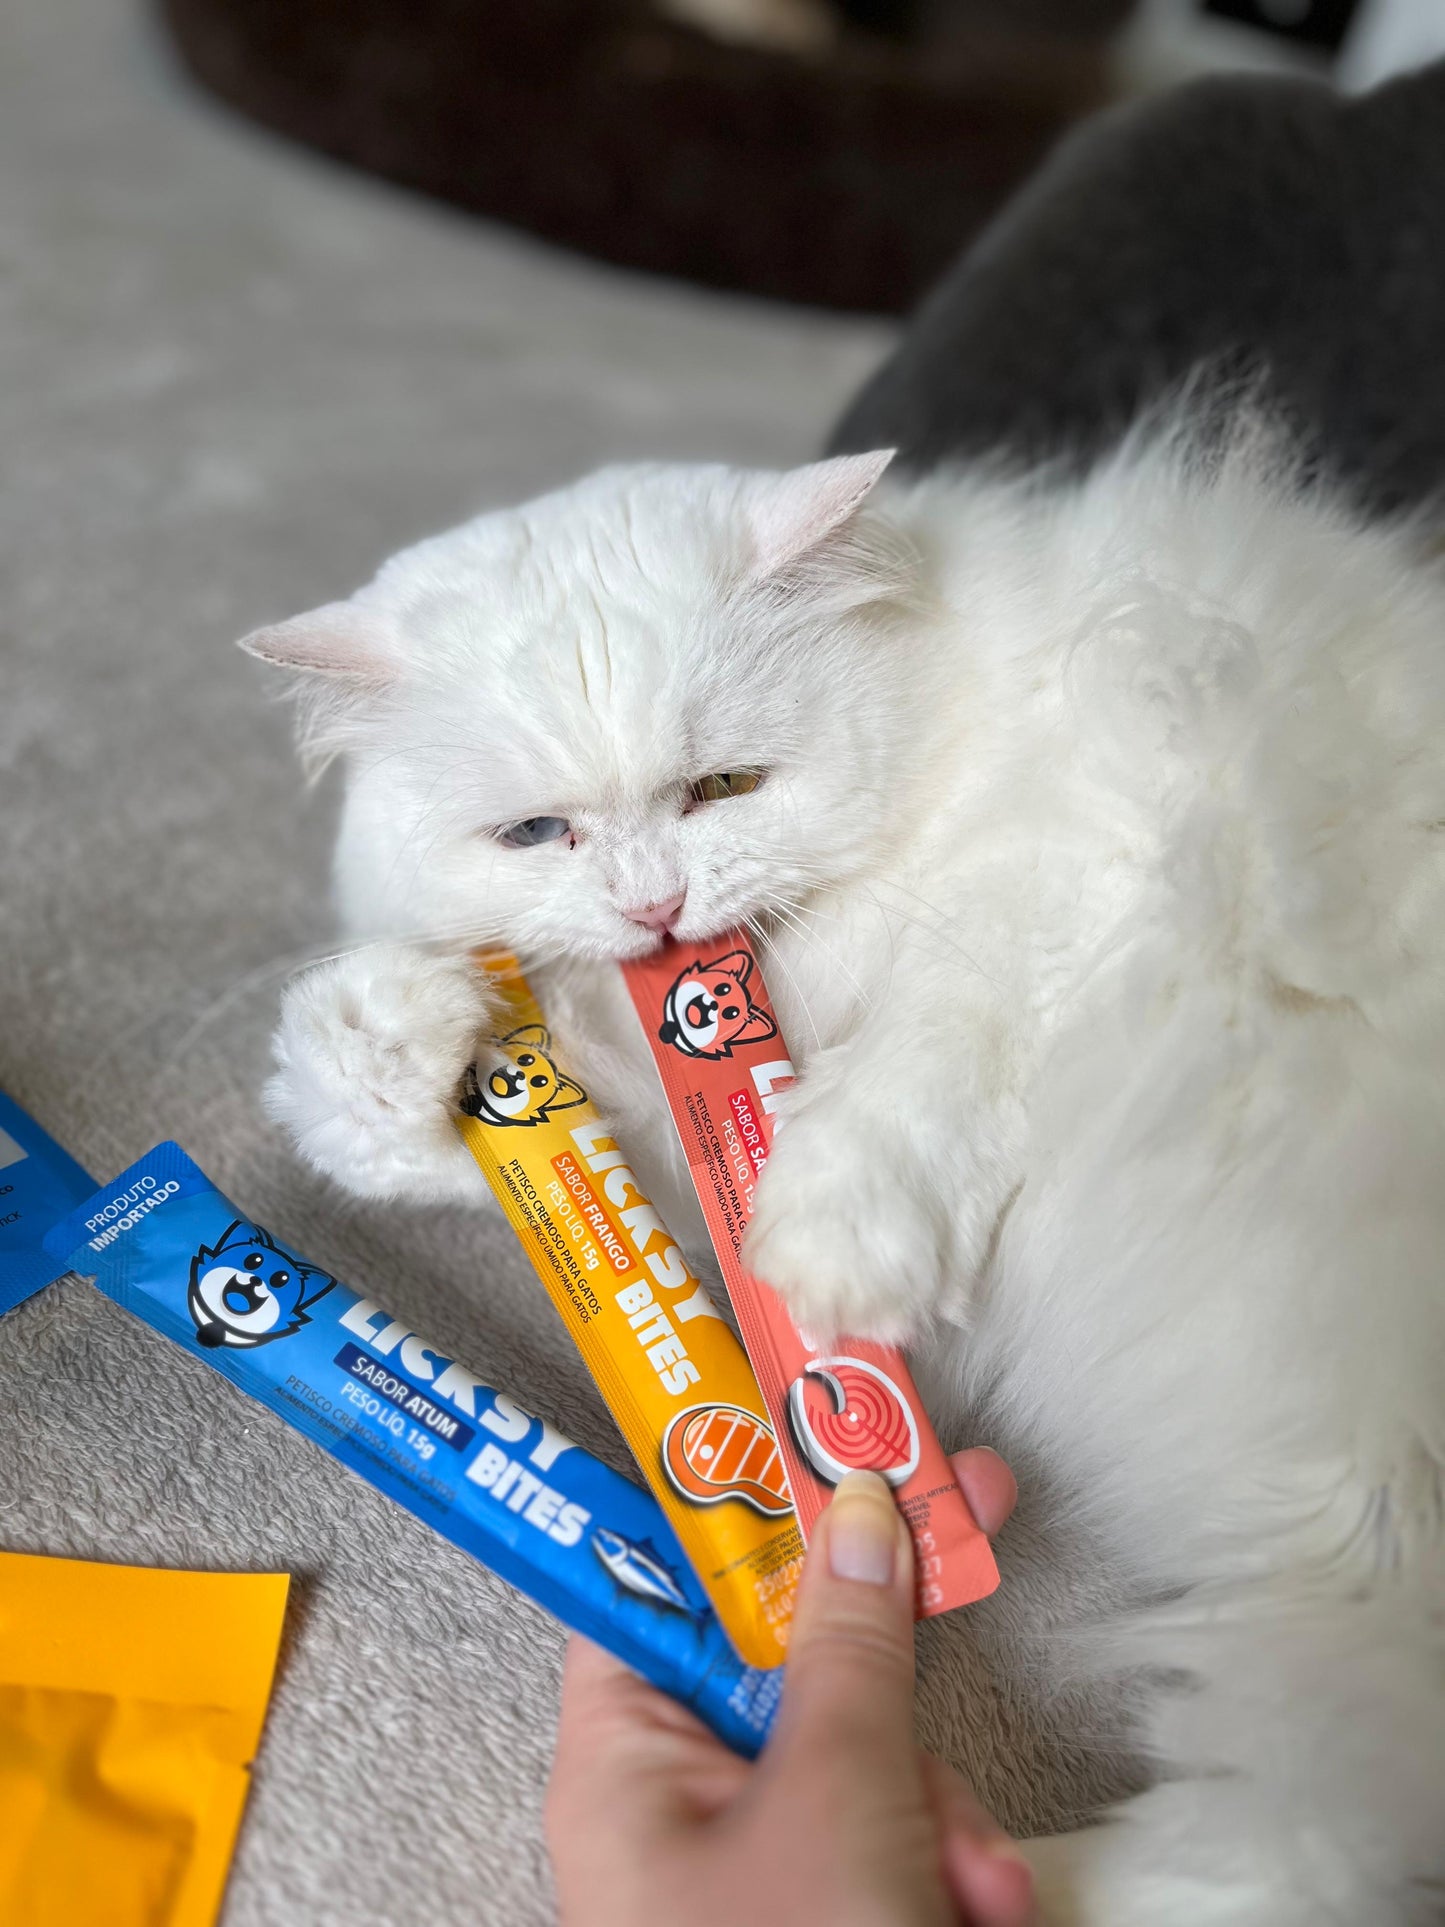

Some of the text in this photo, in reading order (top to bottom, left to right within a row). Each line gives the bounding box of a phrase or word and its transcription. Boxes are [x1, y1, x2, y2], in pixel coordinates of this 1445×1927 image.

[684, 1095, 704, 1136] ALIMENTO
[698, 1135, 719, 1181] ESPECÍFICO
[713, 1179, 728, 1212] ÚMIDO
[724, 1211, 737, 1240] PARA
[694, 1091, 714, 1135] PETISCO
[710, 1136, 734, 1190] CREMOSO
[728, 1188, 747, 1221] PARA
[721, 1119, 741, 1156] PESO
[733, 1154, 750, 1184] LÍQ.
[732, 1094, 760, 1147] SABOR
[84, 1175, 157, 1233] PRODUTO
[88, 1180, 181, 1252] IMPORTADO
[497, 1164, 592, 1324] ALIMENTO ESPECÍFICO ÚMIDO PARA GATOS
[509, 1158, 602, 1315] PETISCO CREMOSO PARA GATOS
[546, 1180, 600, 1271] PESO LÍQ. 15g
[556, 1156, 630, 1270] SABOR FRANGO
[569, 1121, 724, 1324] LICKSY
[338, 1298, 584, 1472] LICKSY
[614, 1278, 702, 1396] BITES
[285, 1374, 333, 1412] PETISCO
[332, 1408, 388, 1451] CREMOSO
[388, 1447, 418, 1474] PARA
[340, 1381, 438, 1460] PESO LÍQ. 15g
[351, 1356, 459, 1439] SABOR ATUM
[464, 1442, 592, 1547] BITES
